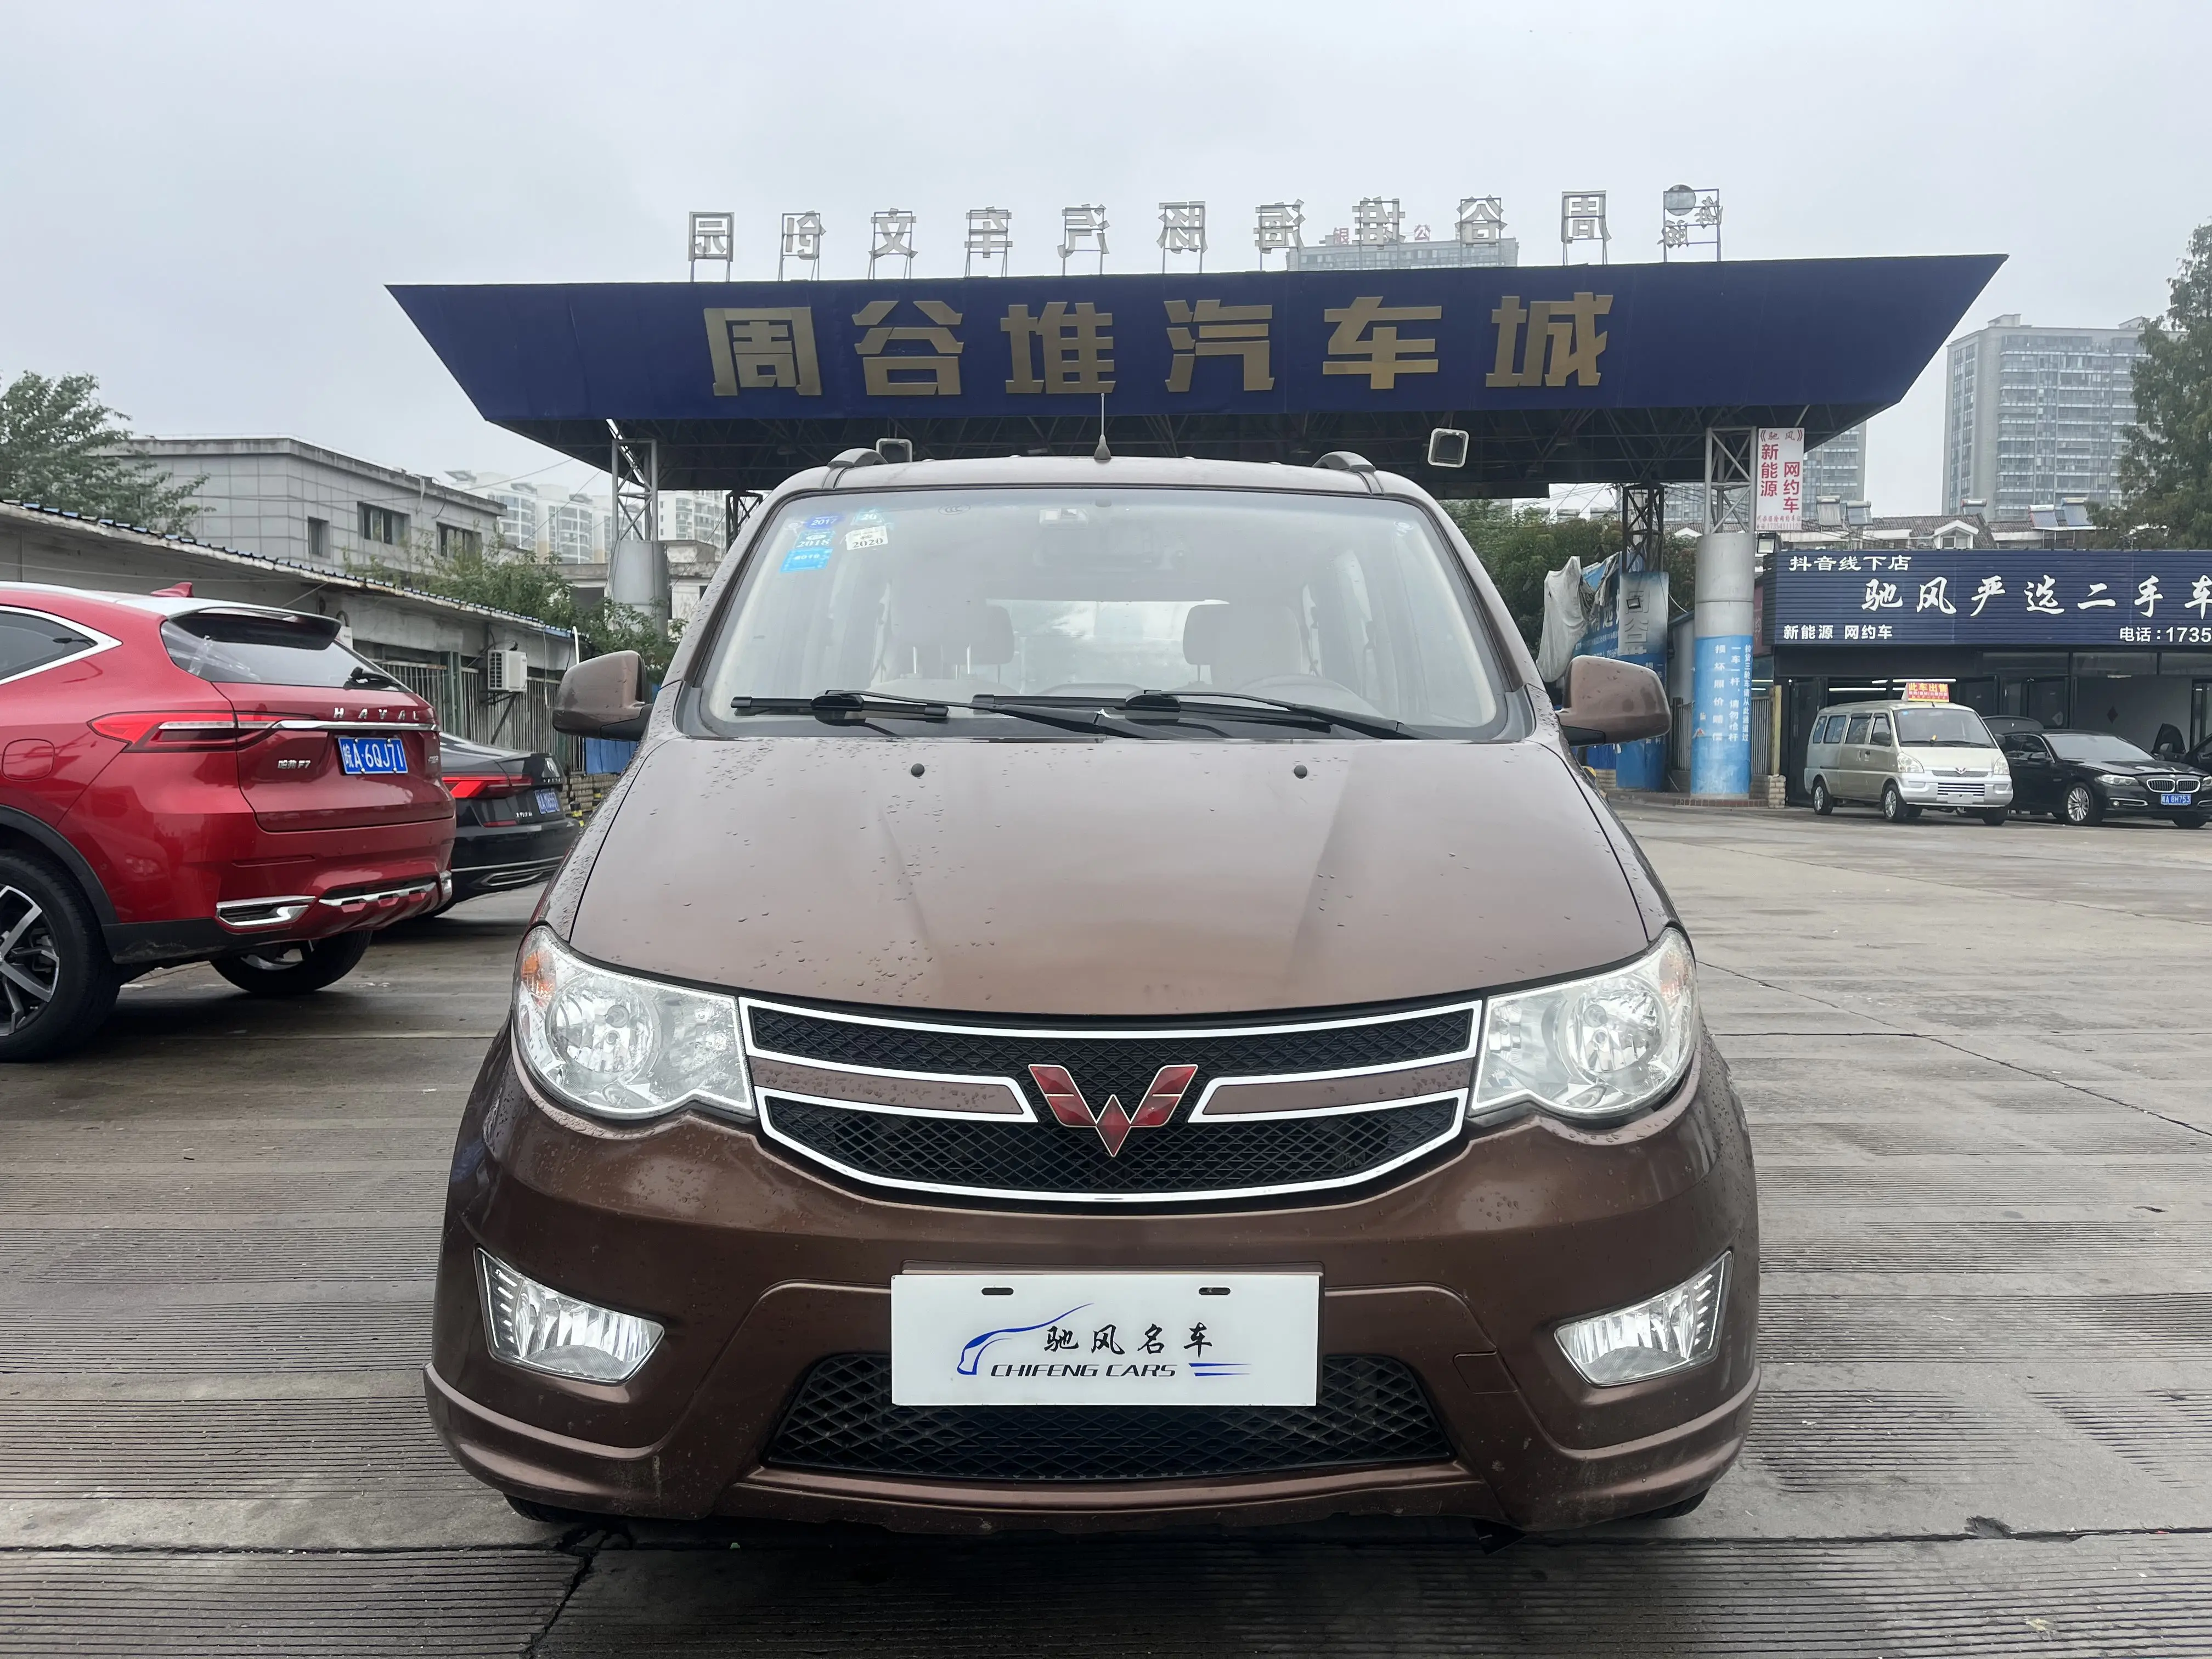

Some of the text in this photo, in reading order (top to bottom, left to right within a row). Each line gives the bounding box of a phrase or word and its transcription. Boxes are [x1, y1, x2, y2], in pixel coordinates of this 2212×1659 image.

[703, 292, 1613, 397] 周谷堆汽车城
[1760, 443, 1779, 497] 新能源
[1783, 461, 1801, 514] 网约车
[796, 538, 831, 548] 2018
[853, 538, 884, 549] 2020
[1788, 555, 1912, 572] 抖音线下店
[1861, 574, 2212, 620] 驰风严选二手车
[1783, 624, 1893, 640] 新能源 网约车
[333, 707, 420, 721] HAVAL
[297, 759, 312, 769] F7
[1043, 1321, 1213, 1359] 驰风名车
[991, 1364, 1177, 1378] CHIFENG CARS
